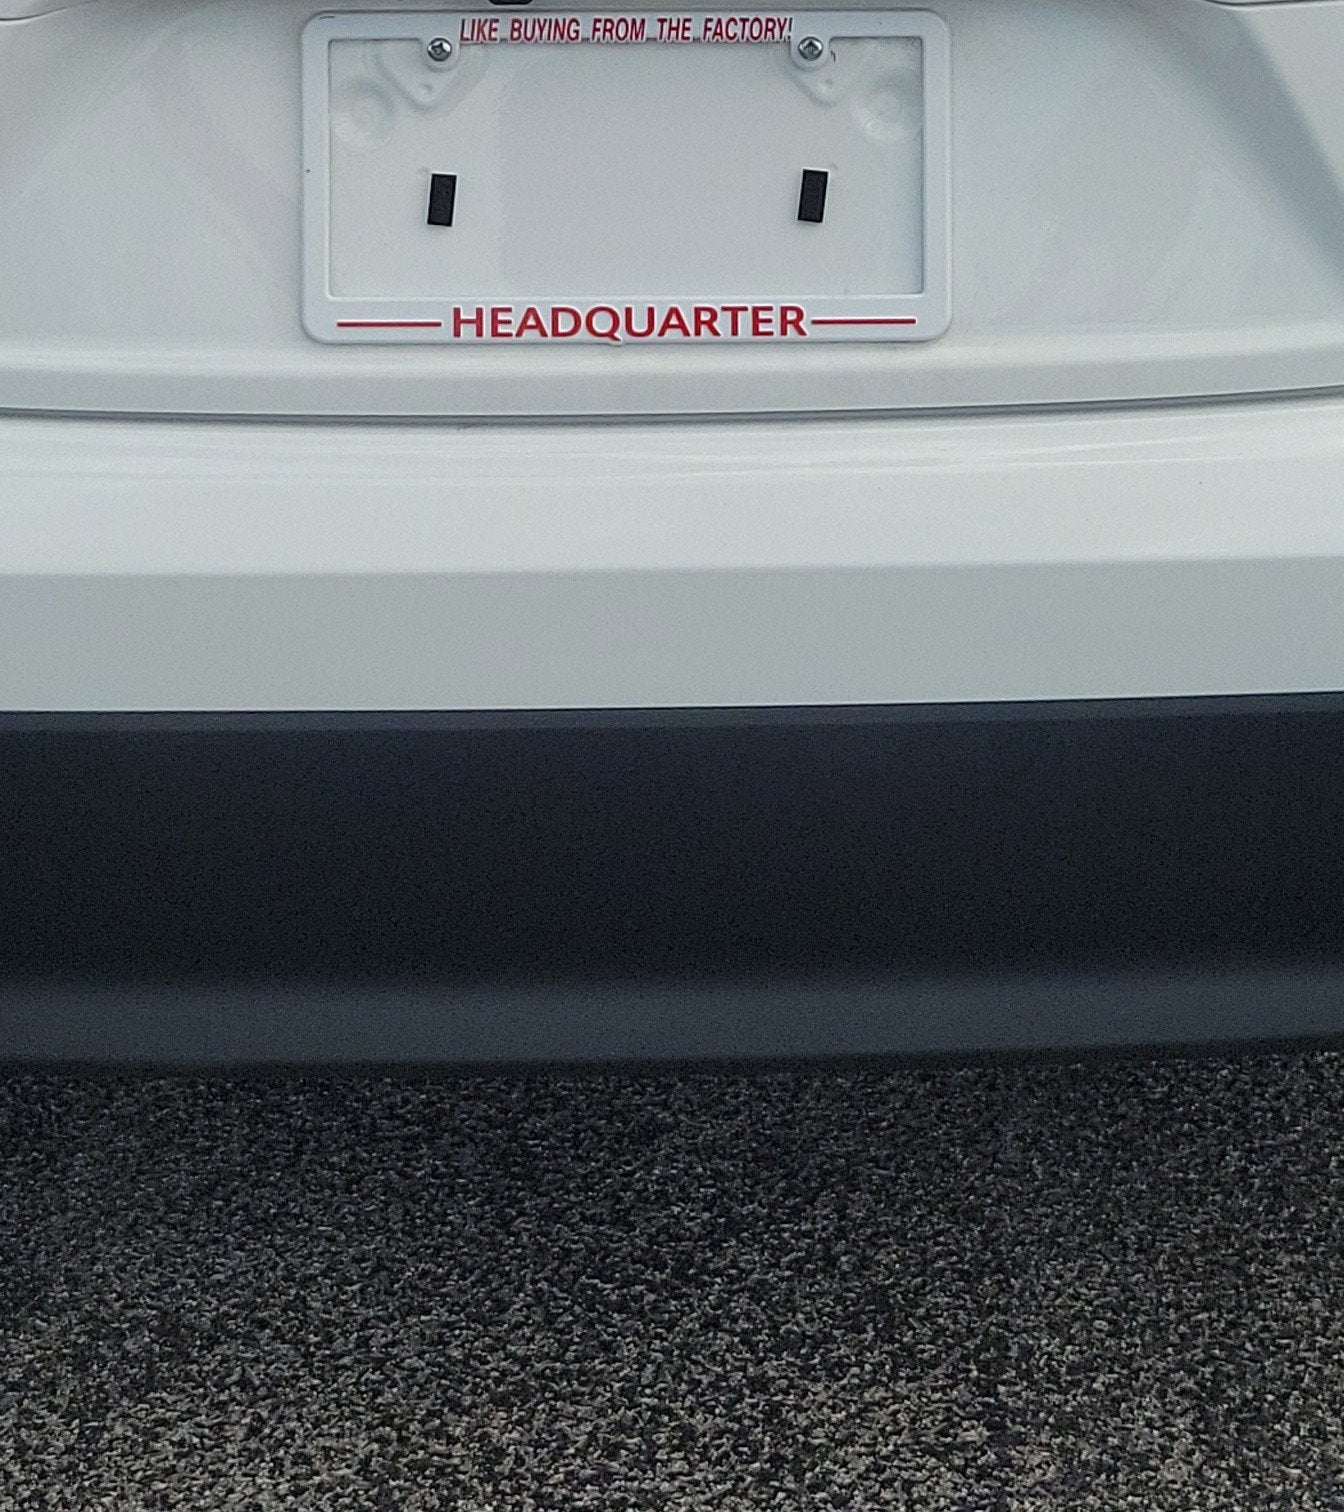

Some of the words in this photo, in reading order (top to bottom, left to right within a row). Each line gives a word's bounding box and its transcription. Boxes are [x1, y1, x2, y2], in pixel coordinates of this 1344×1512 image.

[459, 17, 500, 42] LIKE
[510, 17, 580, 42] BUYING
[591, 17, 646, 42] FROM
[656, 17, 692, 42] THE
[702, 16, 793, 42] FACTORY!
[452, 304, 809, 341] HEADQUARTER
